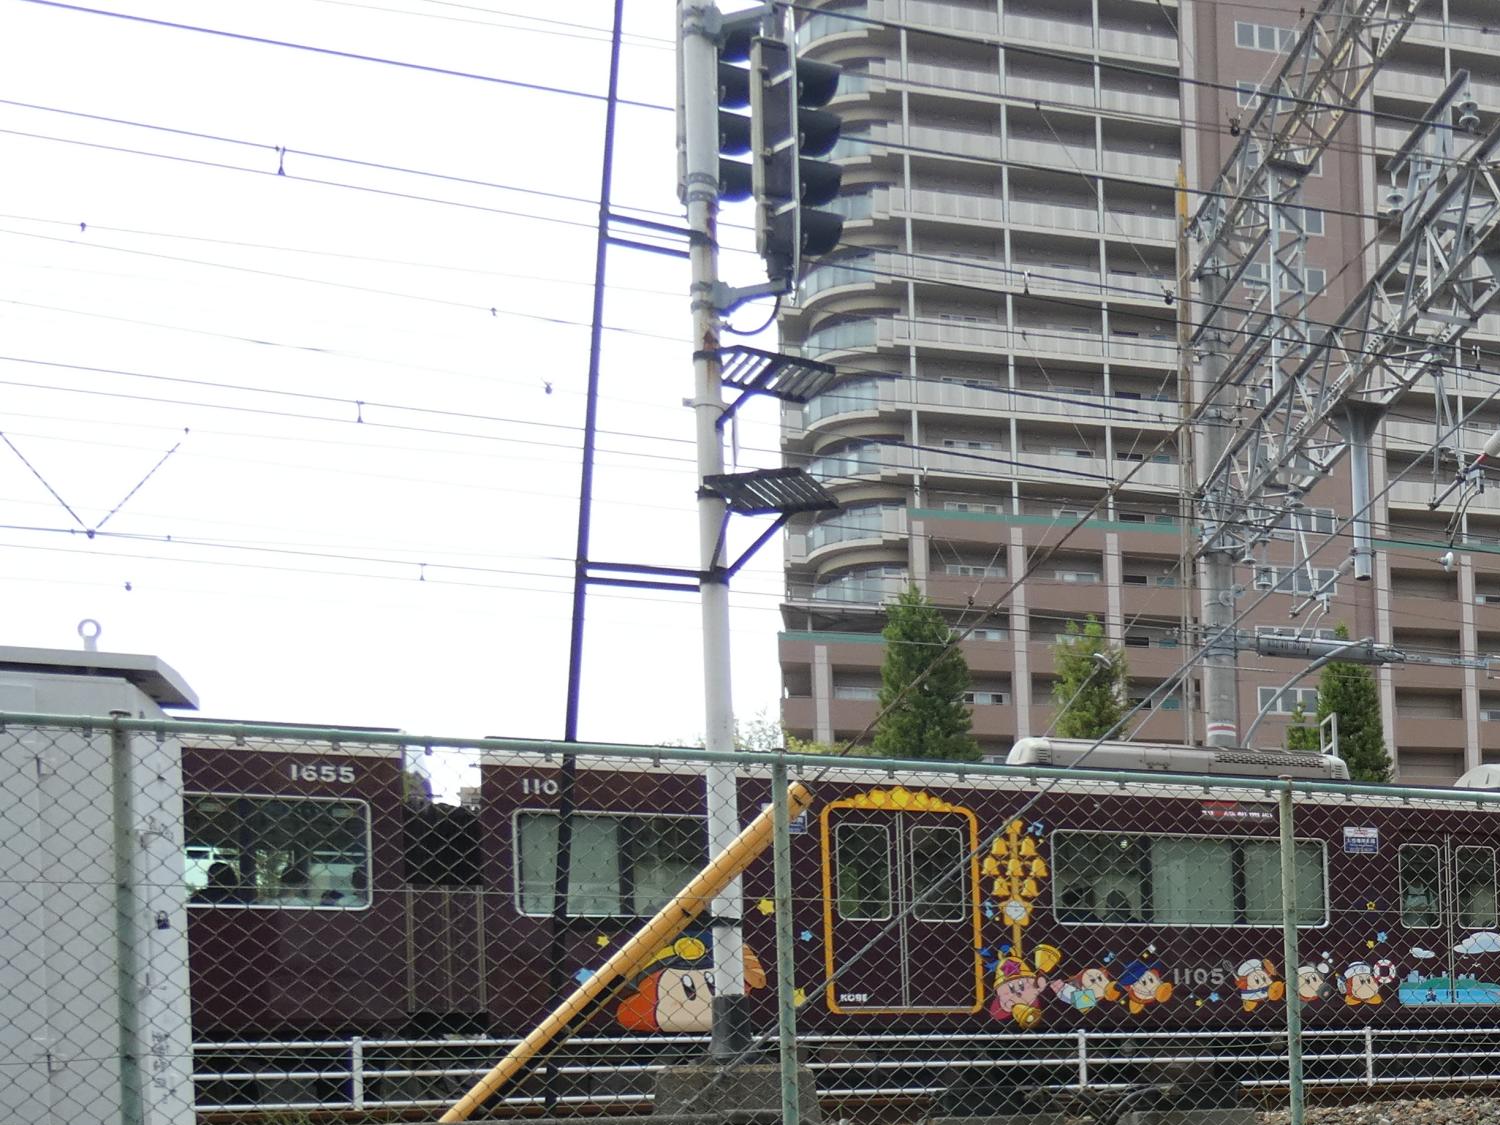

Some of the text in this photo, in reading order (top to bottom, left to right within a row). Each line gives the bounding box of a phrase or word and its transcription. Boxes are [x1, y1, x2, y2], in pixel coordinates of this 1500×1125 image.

[290, 764, 356, 784] 1655
[522, 778, 561, 796] 110
[1173, 967, 1225, 985] 1105
[839, 993, 869, 1003] KOBE
